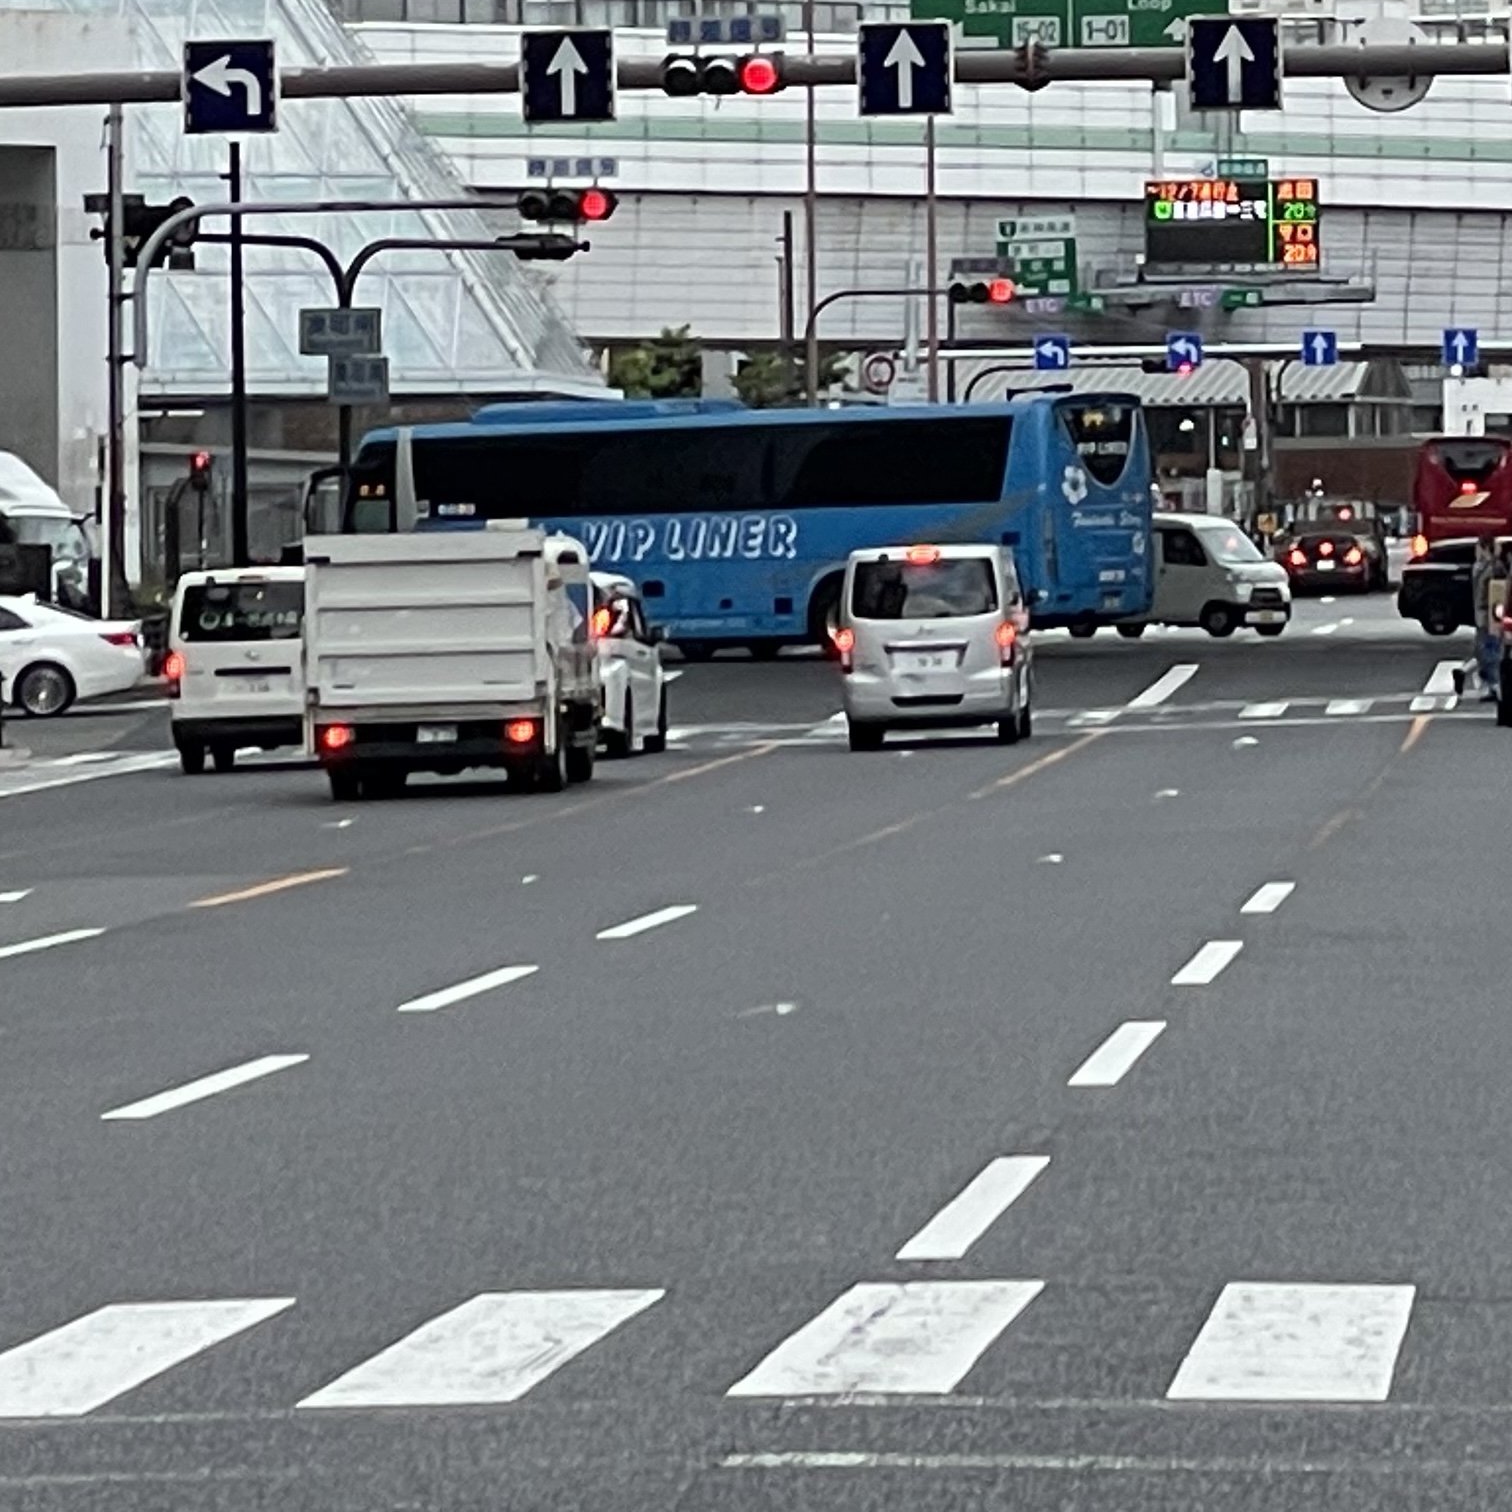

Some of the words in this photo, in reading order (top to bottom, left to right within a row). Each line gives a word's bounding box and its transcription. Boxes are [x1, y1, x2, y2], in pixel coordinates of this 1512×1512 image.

[1085, 19, 1128, 42] 1-01
[580, 519, 656, 562] VIP
[663, 514, 798, 561] LINER
